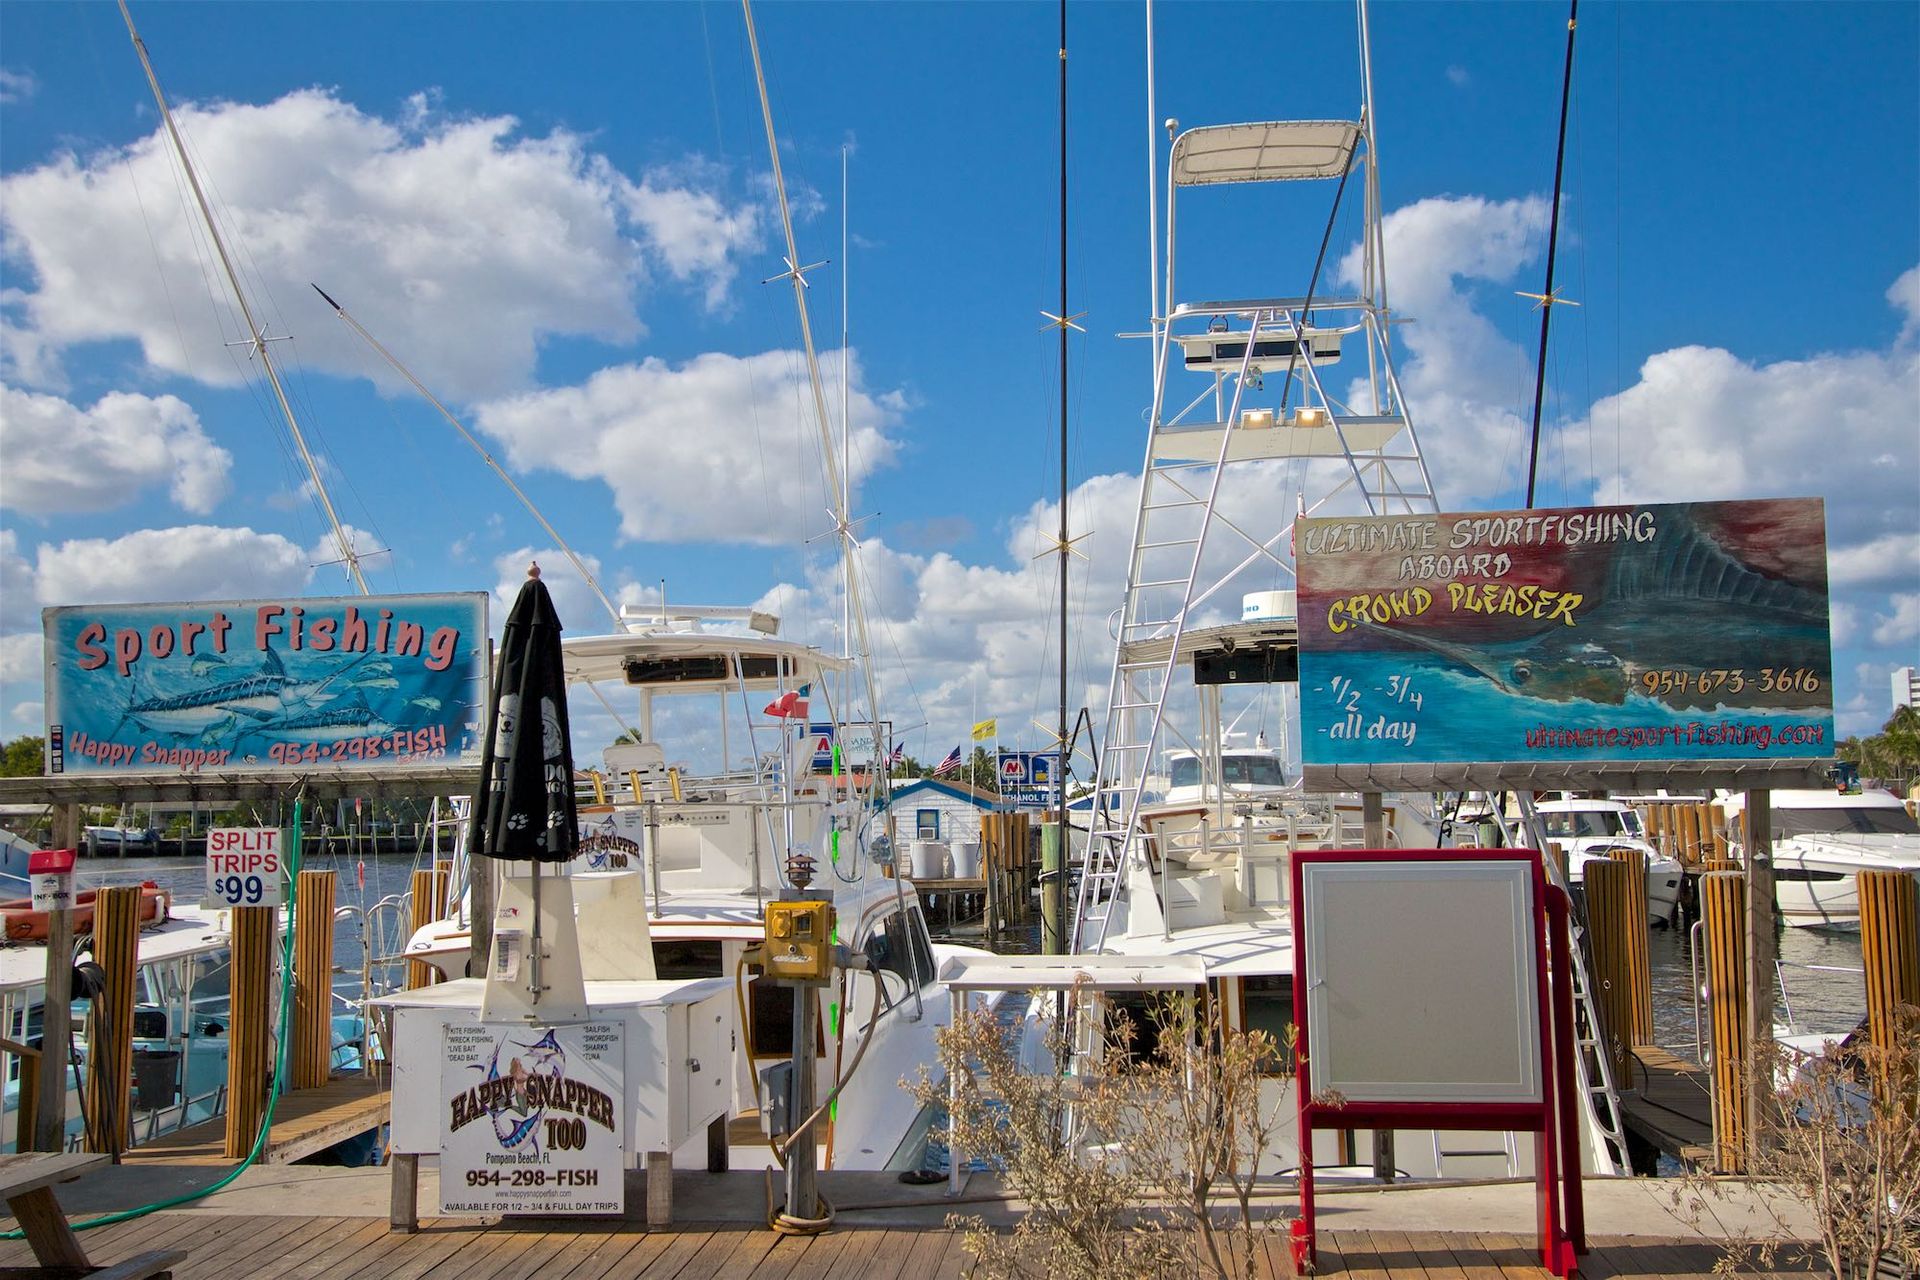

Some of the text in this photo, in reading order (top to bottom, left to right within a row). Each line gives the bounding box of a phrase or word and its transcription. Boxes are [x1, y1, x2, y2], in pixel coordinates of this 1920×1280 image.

[1304, 511, 1657, 556] ULTIMATE SPORTFISHING
[1398, 552, 1512, 581] ABOARD
[1327, 582, 1585, 634] CROWD PLEASER
[75, 605, 460, 678] Sport Fishing
[1642, 666, 1820, 695] 954-673-3616
[1367, 715, 1417, 747] day
[69, 731, 136, 766] Happy
[142, 741, 231, 771] Snapper
[211, 831, 277, 851] SPLIT
[600, 834, 640, 859] SNAPPER
[210, 854, 279, 873] TRIPS
[215, 875, 263, 904] $99
[450, 1073, 616, 1133] HAPPY SNAPPER
[544, 1117, 587, 1151] TOO
[486, 1152, 516, 1165] Pompano
[466, 1169, 599, 1187] 954-298-FISH
[553, 1202, 574, 1210] FULL
[576, 1202, 592, 1210] DAY
[595, 1202, 619, 1210] TRIPS
